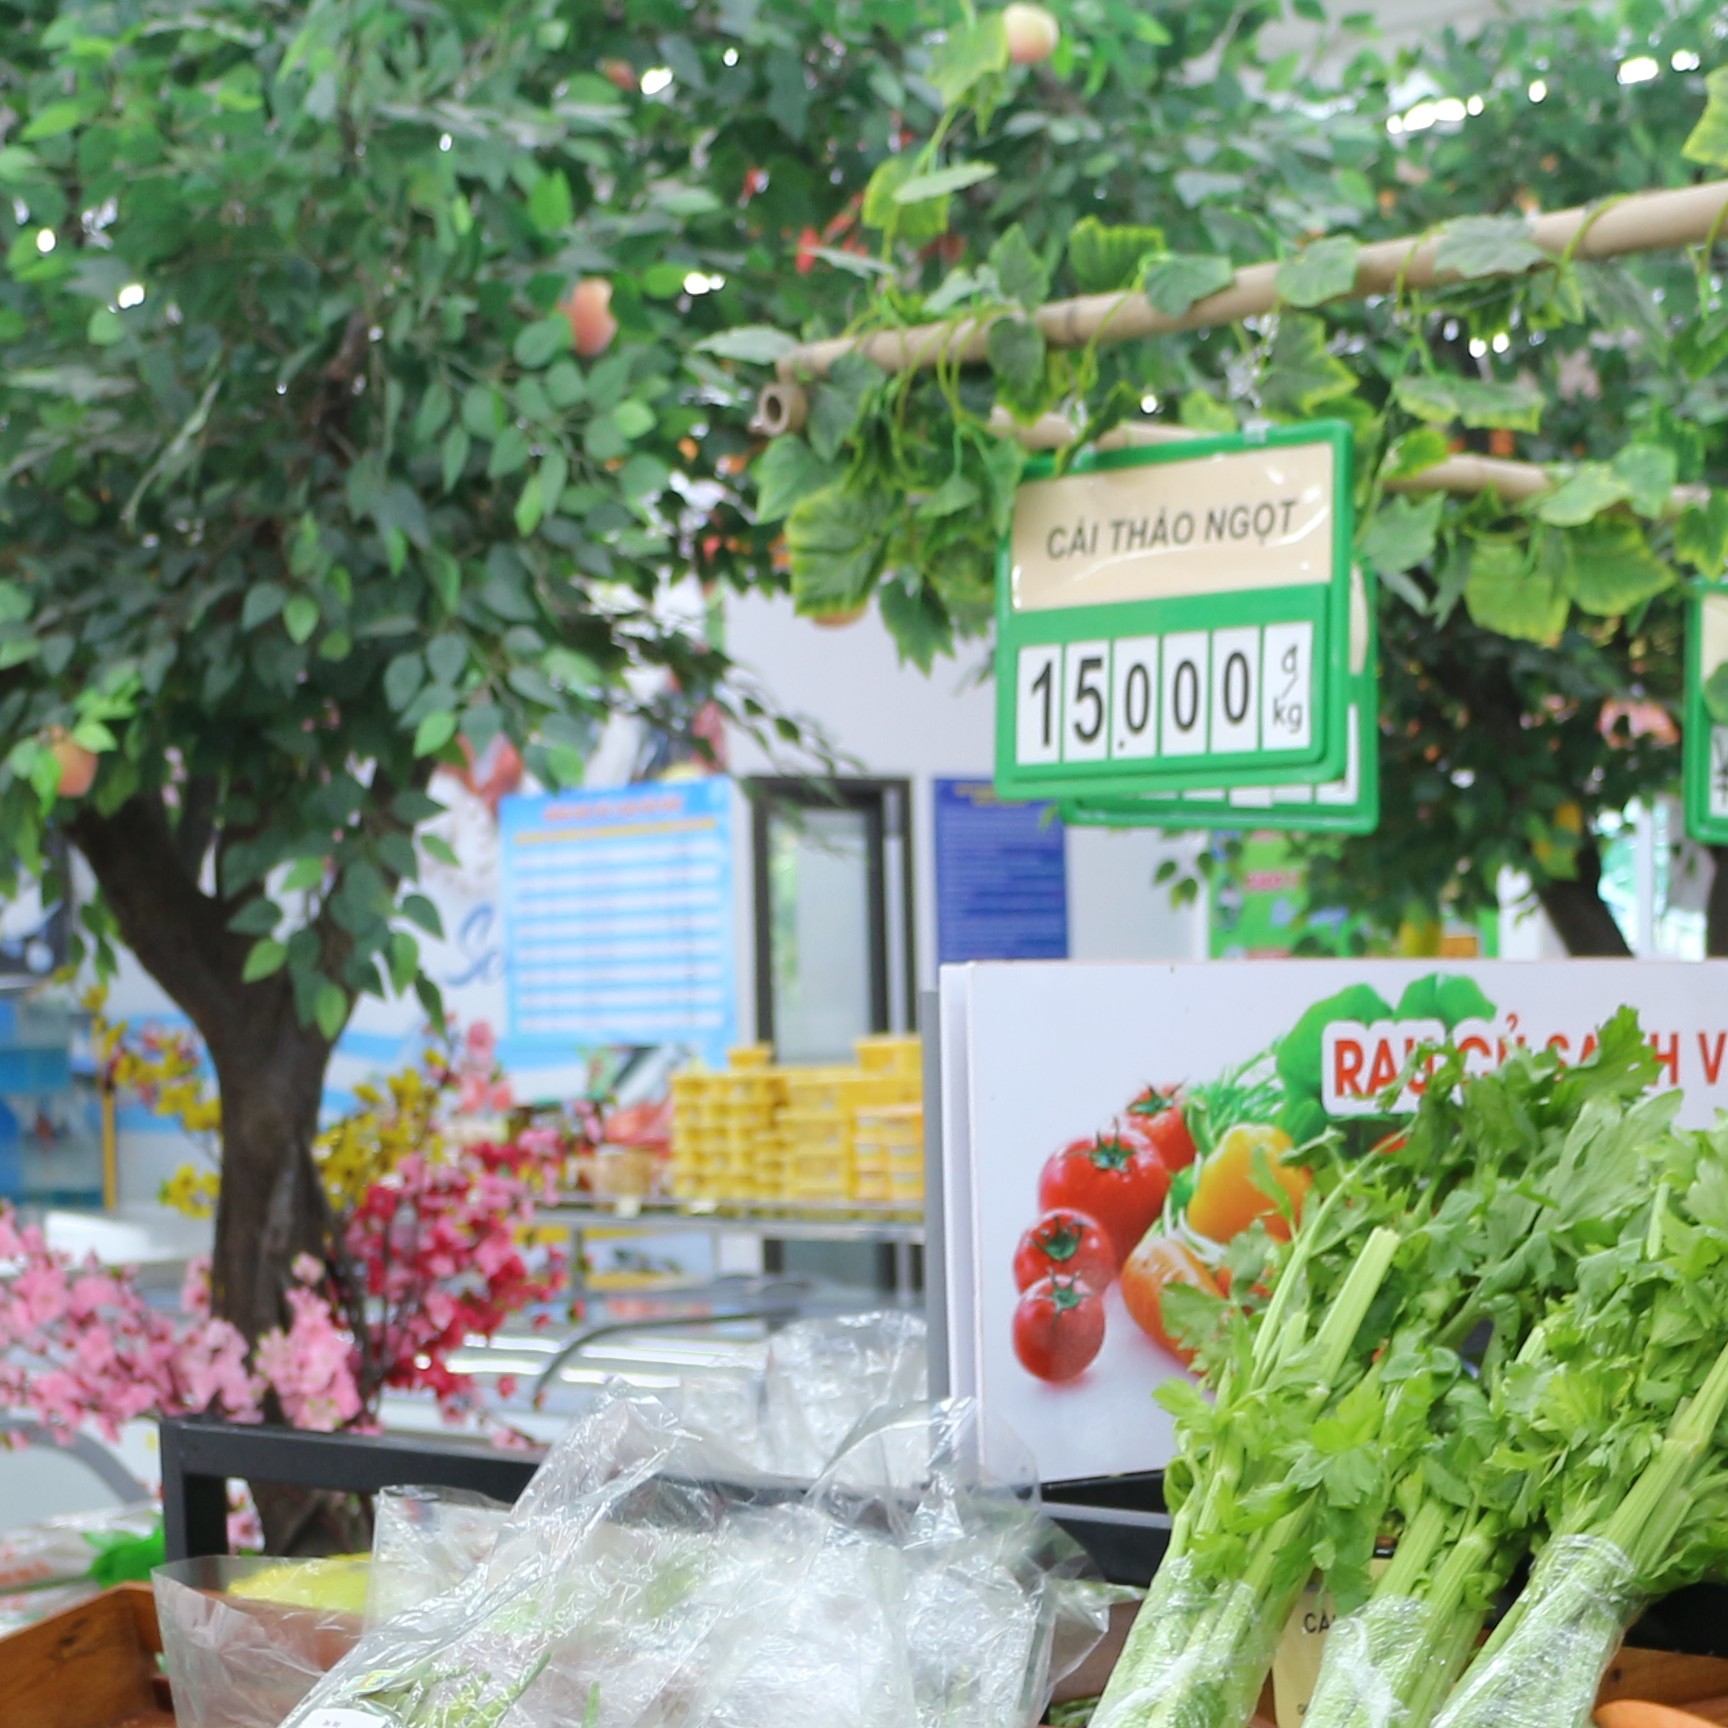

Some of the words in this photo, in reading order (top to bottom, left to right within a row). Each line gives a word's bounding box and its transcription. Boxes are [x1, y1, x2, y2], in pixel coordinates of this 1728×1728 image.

[1046, 516, 1098, 560] CẢI
[1109, 508, 1195, 552] THẢO
[1204, 499, 1296, 545] NGỌT
